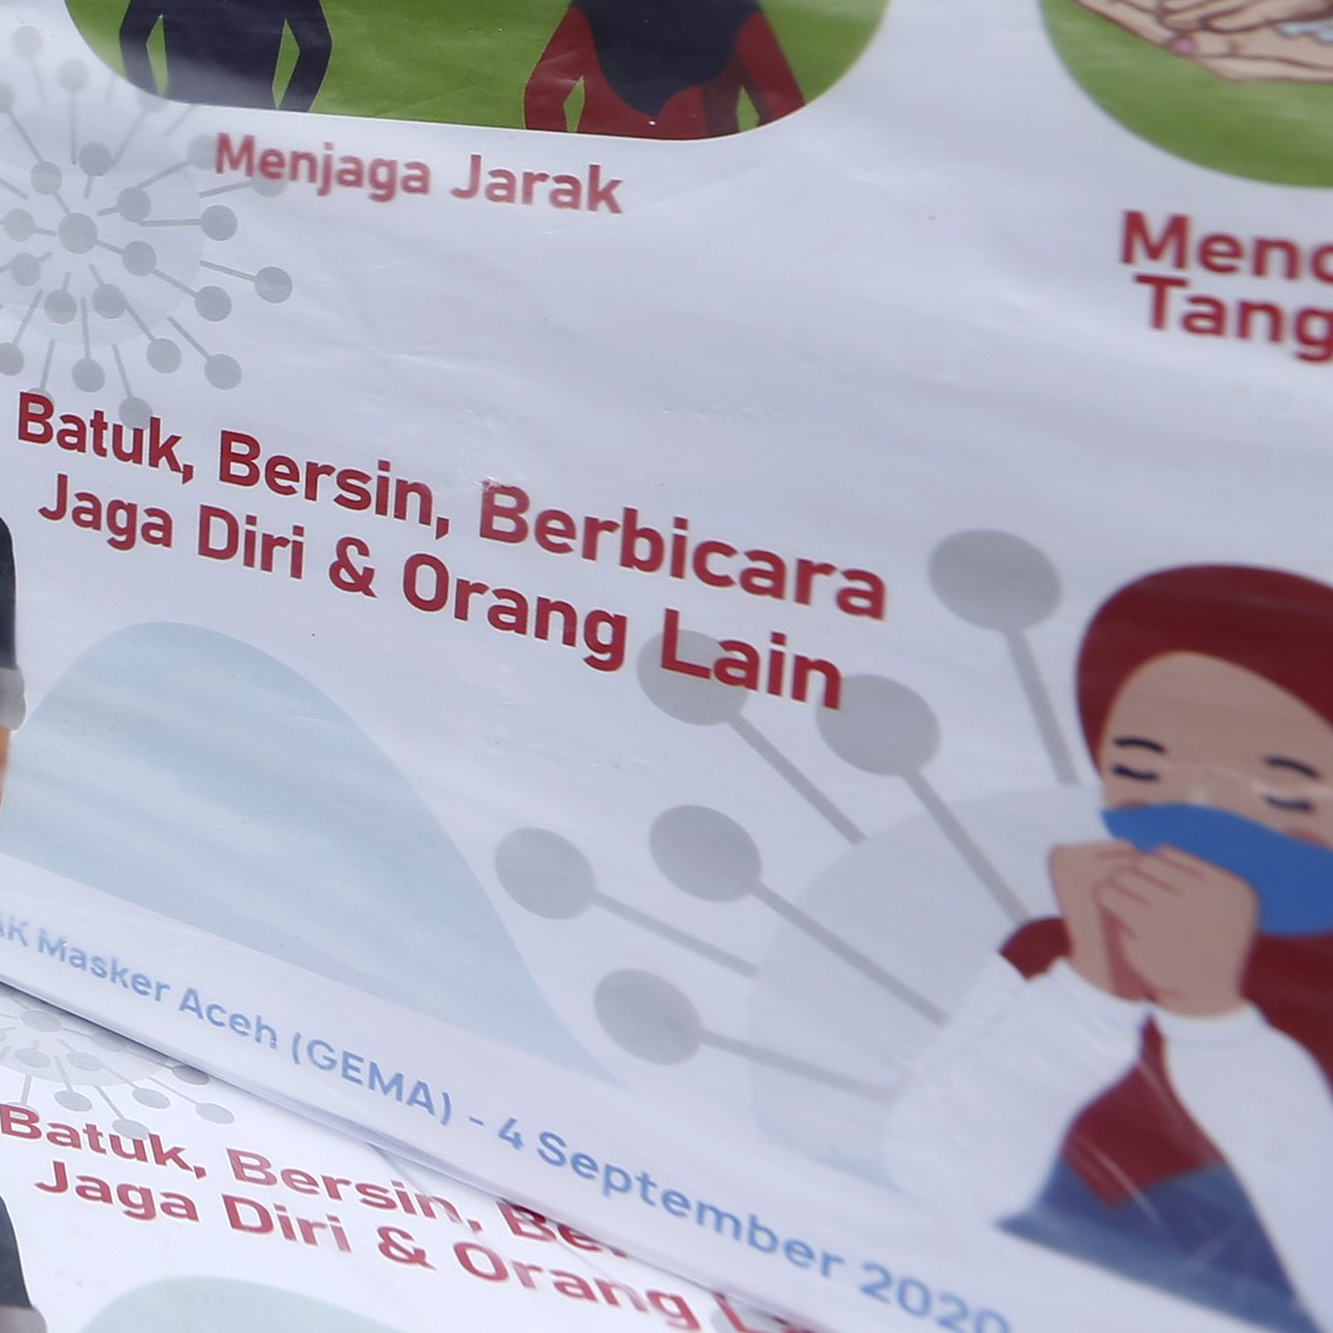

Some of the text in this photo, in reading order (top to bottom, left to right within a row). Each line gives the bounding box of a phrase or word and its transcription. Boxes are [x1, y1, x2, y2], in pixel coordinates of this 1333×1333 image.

[214, 133, 624, 215] Menjaga Jarak
[16, 391, 887, 623] Batuk, Bersin, Berbicara
[38, 473, 842, 712] Jaga Diri & Orang Lain
[37, 927, 171, 1005] Masker
[178, 987, 278, 1053] Aceh
[291, 1032, 453, 1126] (GEMA)
[497, 1117, 524, 1151] 4
[537, 1131, 845, 1280] September
[859, 1261, 1013, 1333] 2020
[225, 1148, 483, 1234] Bersin,
[35, 1161, 200, 1223] Jaga
[221, 1193, 352, 1253] Diri
[376, 1226, 437, 1271] &
[453, 1241, 701, 1333] Orang
